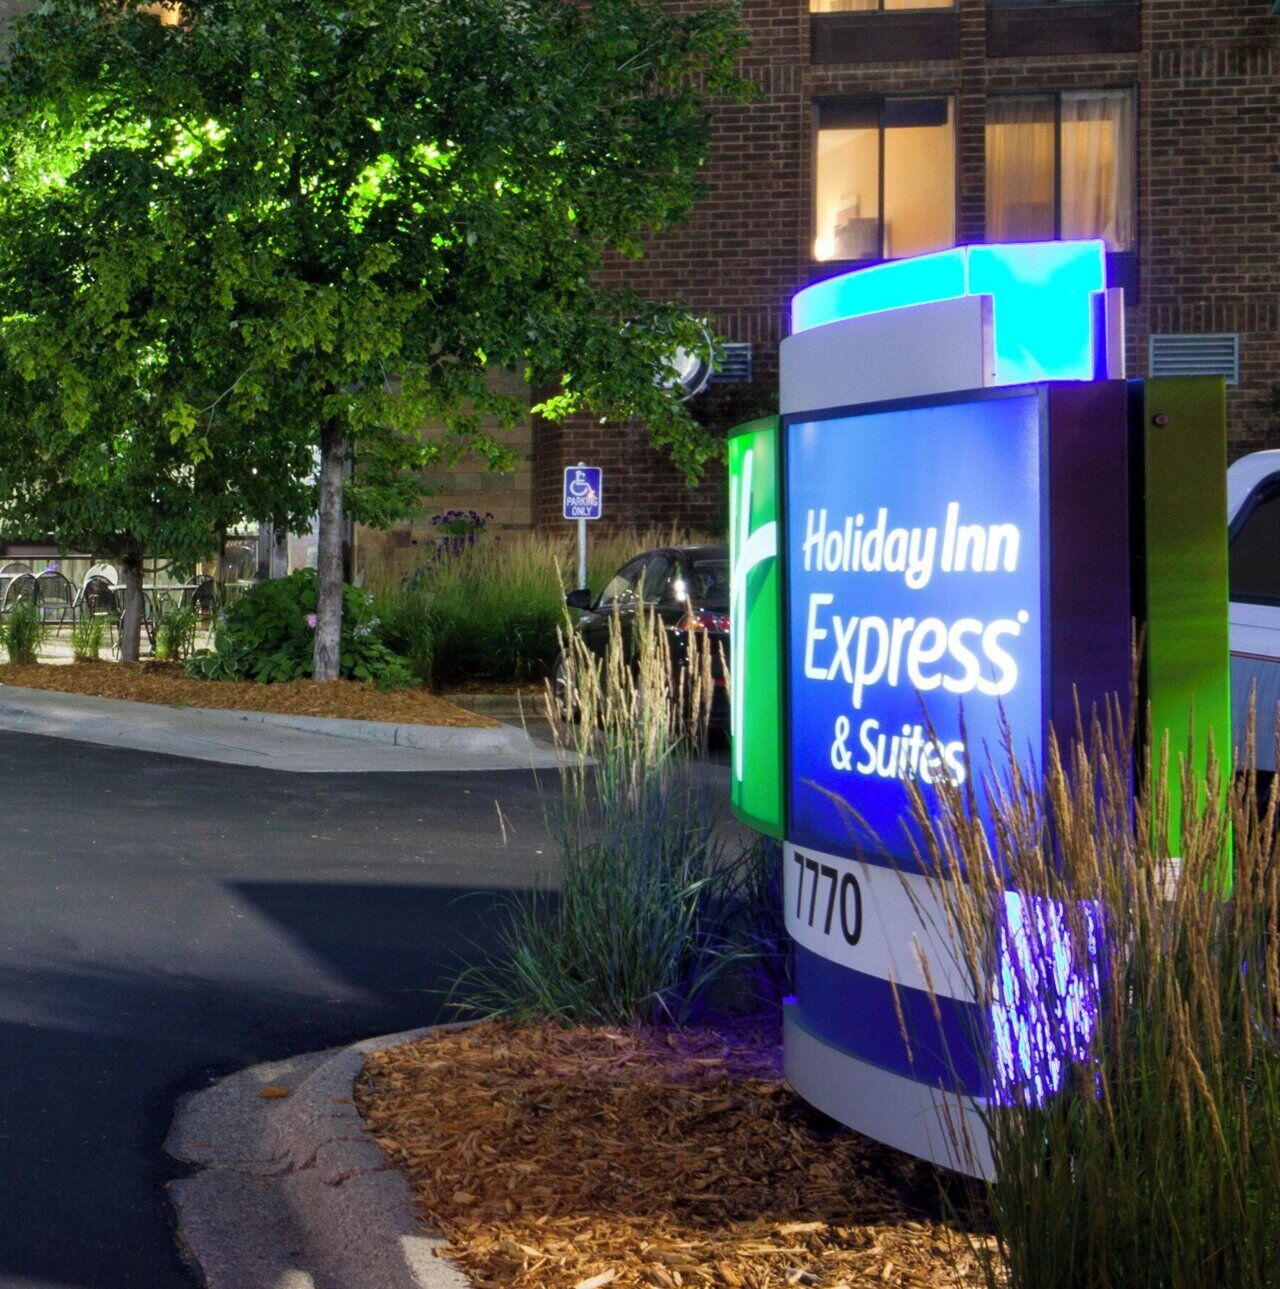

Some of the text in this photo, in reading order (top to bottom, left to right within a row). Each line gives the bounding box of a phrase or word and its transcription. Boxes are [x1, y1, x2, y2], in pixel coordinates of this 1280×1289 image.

[566, 496, 598, 507] PARKING
[571, 506, 593, 516] ONLY
[802, 501, 1020, 590] Holiday Inn
[803, 593, 1025, 710] Express
[829, 714, 967, 787] & Suites
[793, 850, 863, 947] 7770
